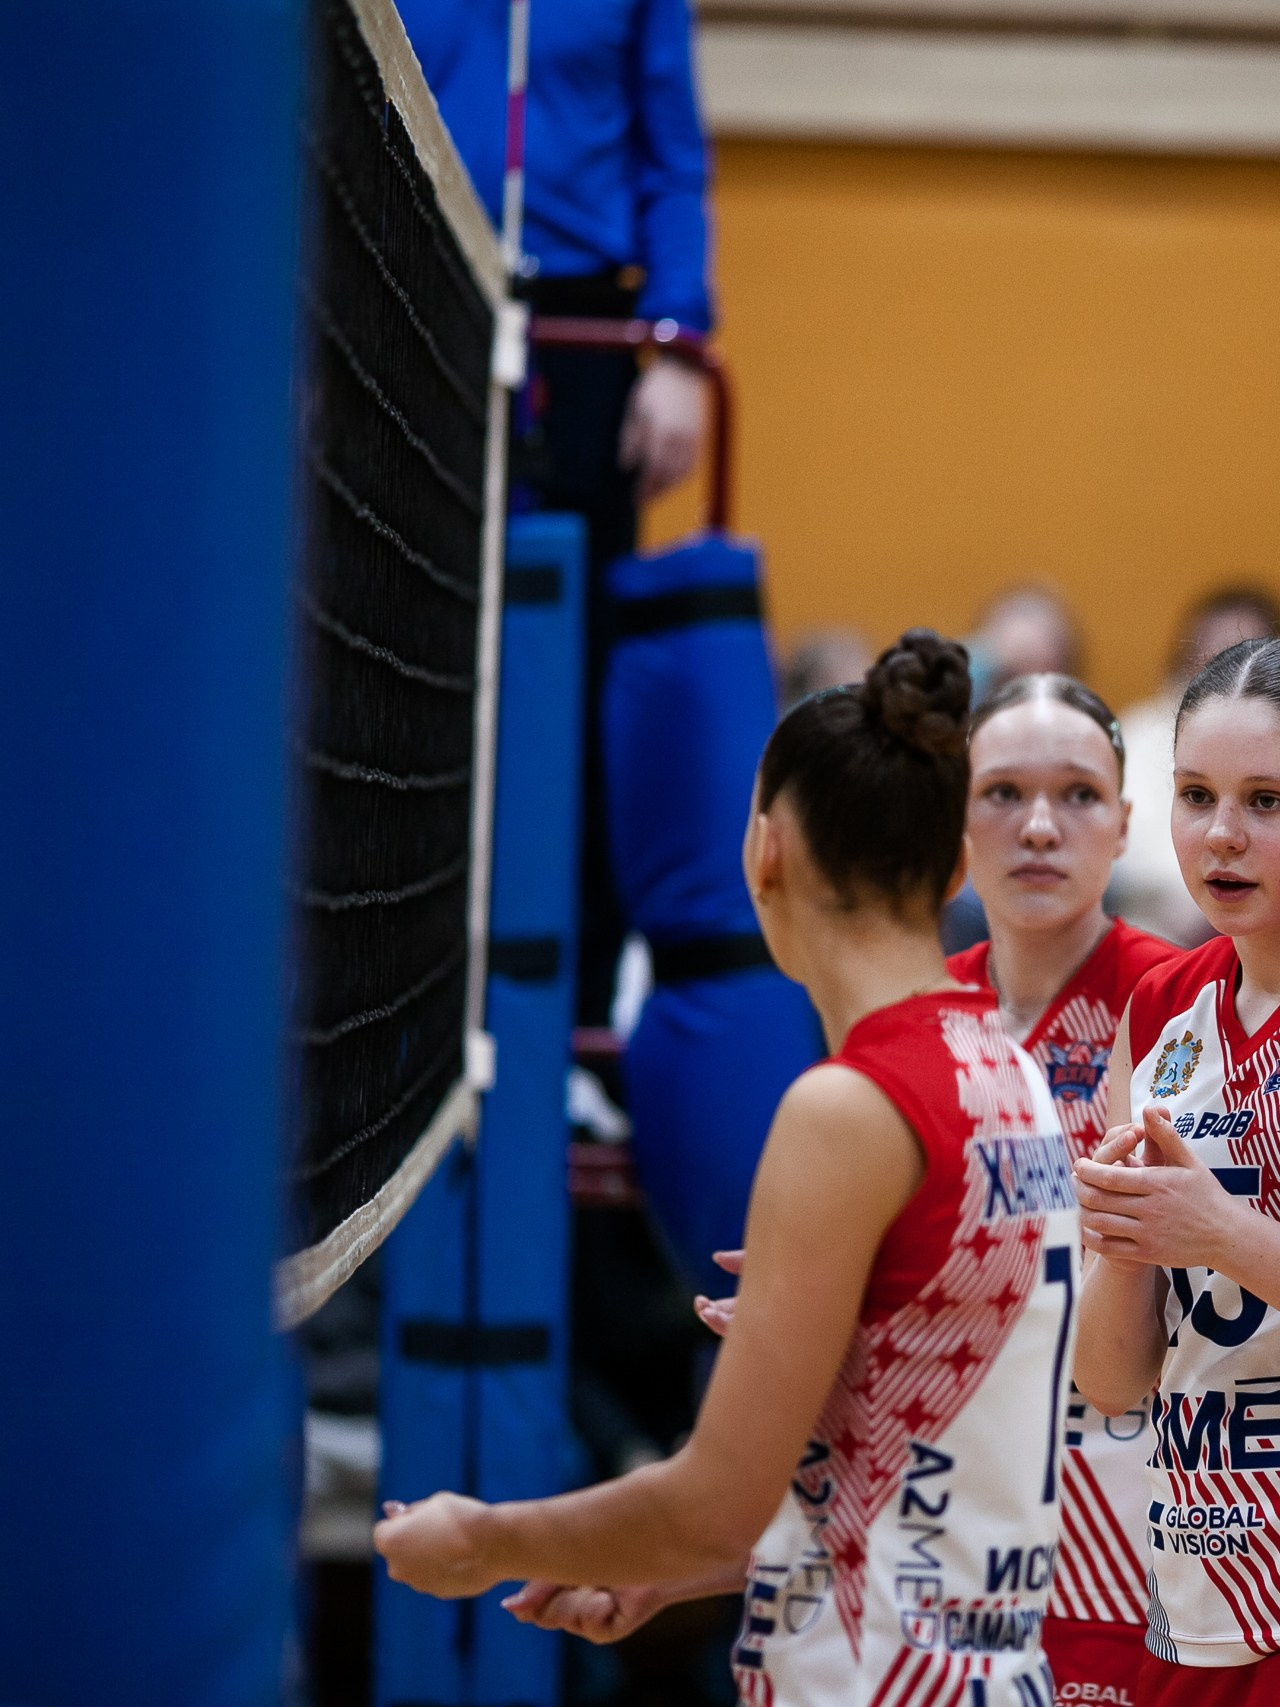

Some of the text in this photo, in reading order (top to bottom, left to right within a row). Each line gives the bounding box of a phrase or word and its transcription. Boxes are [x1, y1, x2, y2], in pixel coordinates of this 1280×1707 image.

[1191, 1110, 1254, 1140] ВФВ
[1165, 1504, 1265, 1530] GLOBAL
[895, 1441, 955, 1652] A2MED
[1166, 1531, 1251, 1556] VISION
[986, 1544, 1059, 1595] ИС
